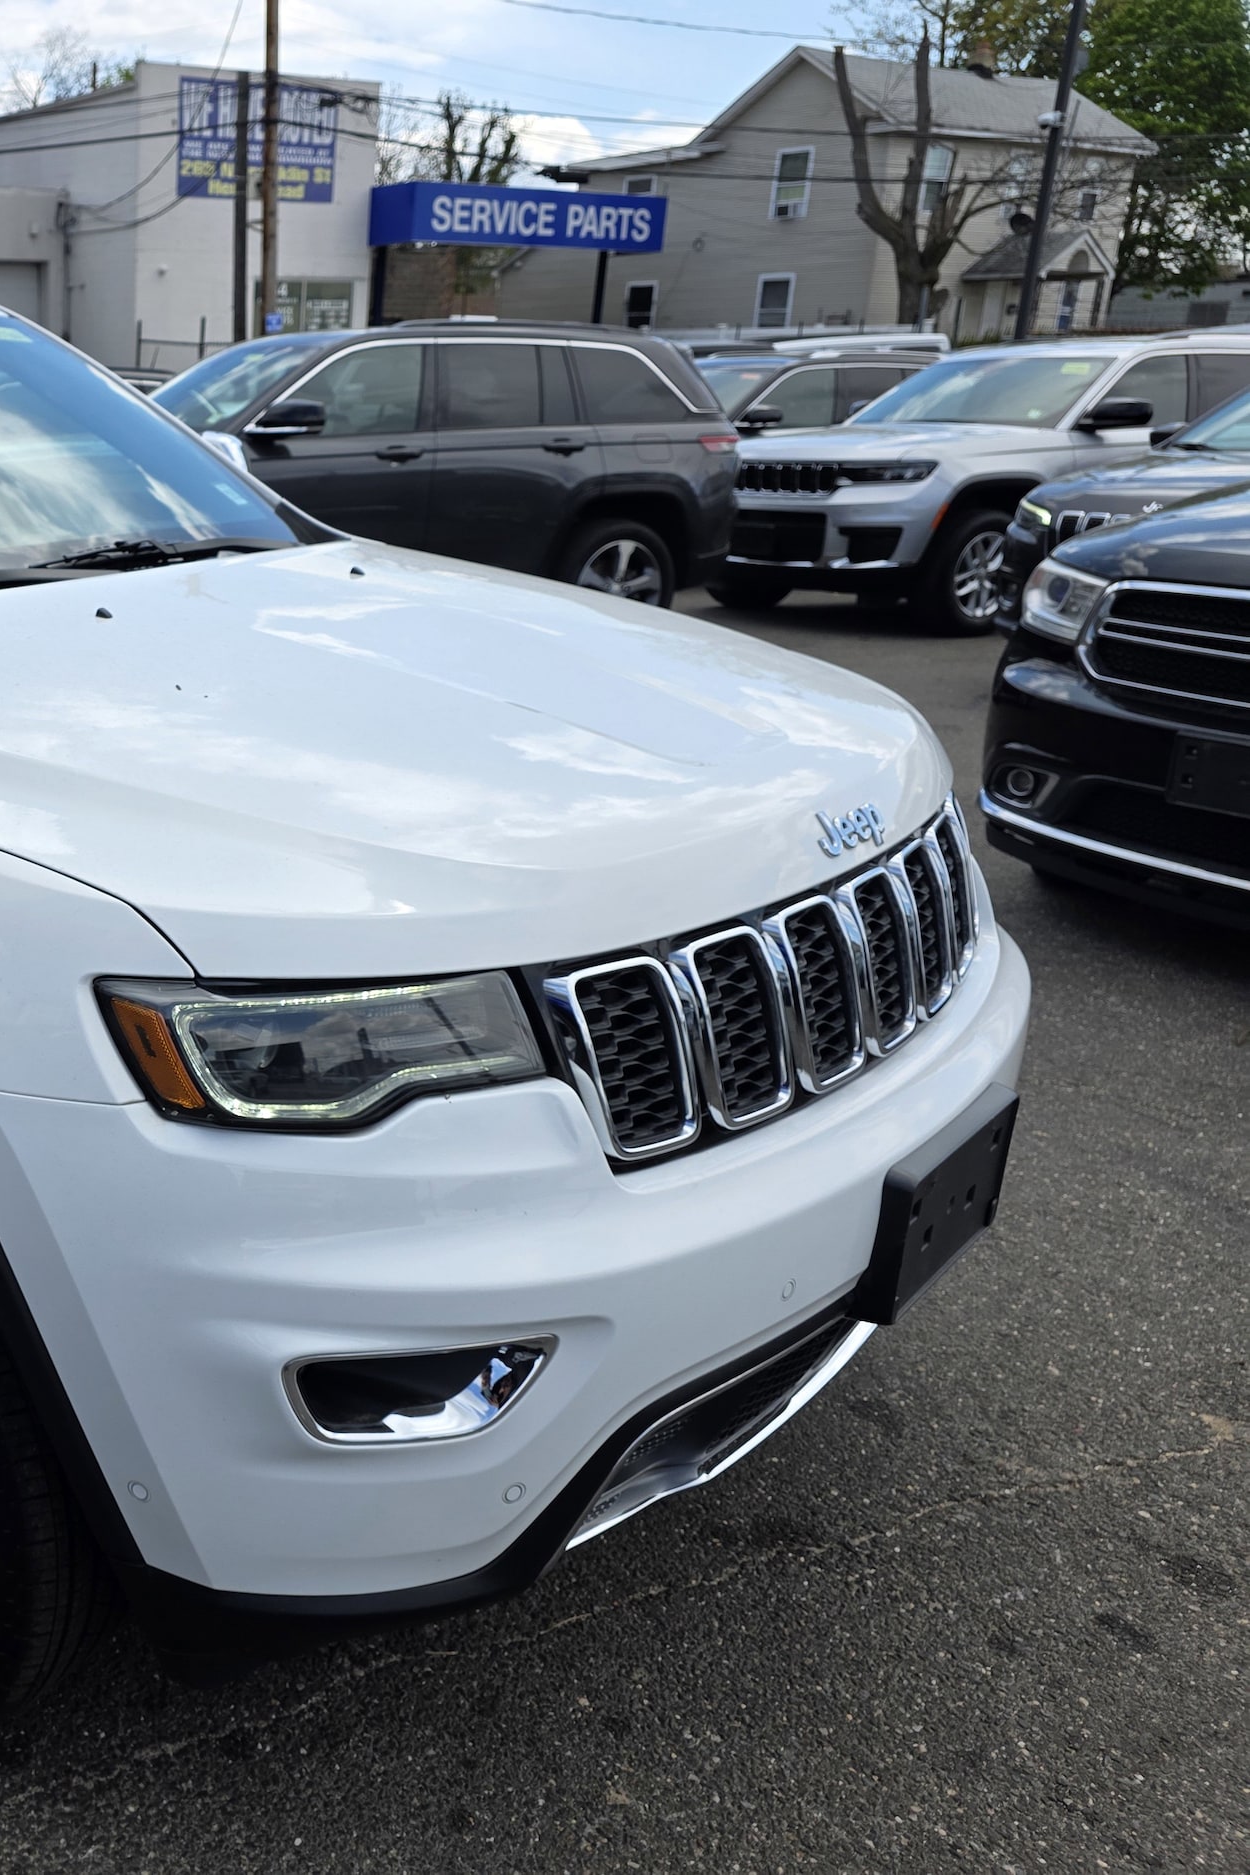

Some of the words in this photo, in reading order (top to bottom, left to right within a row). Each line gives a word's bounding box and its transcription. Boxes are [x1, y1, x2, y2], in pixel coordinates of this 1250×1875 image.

[430, 195, 557, 237] SERVICE
[565, 203, 652, 243] PARTS
[815, 802, 885, 859] Jeep
